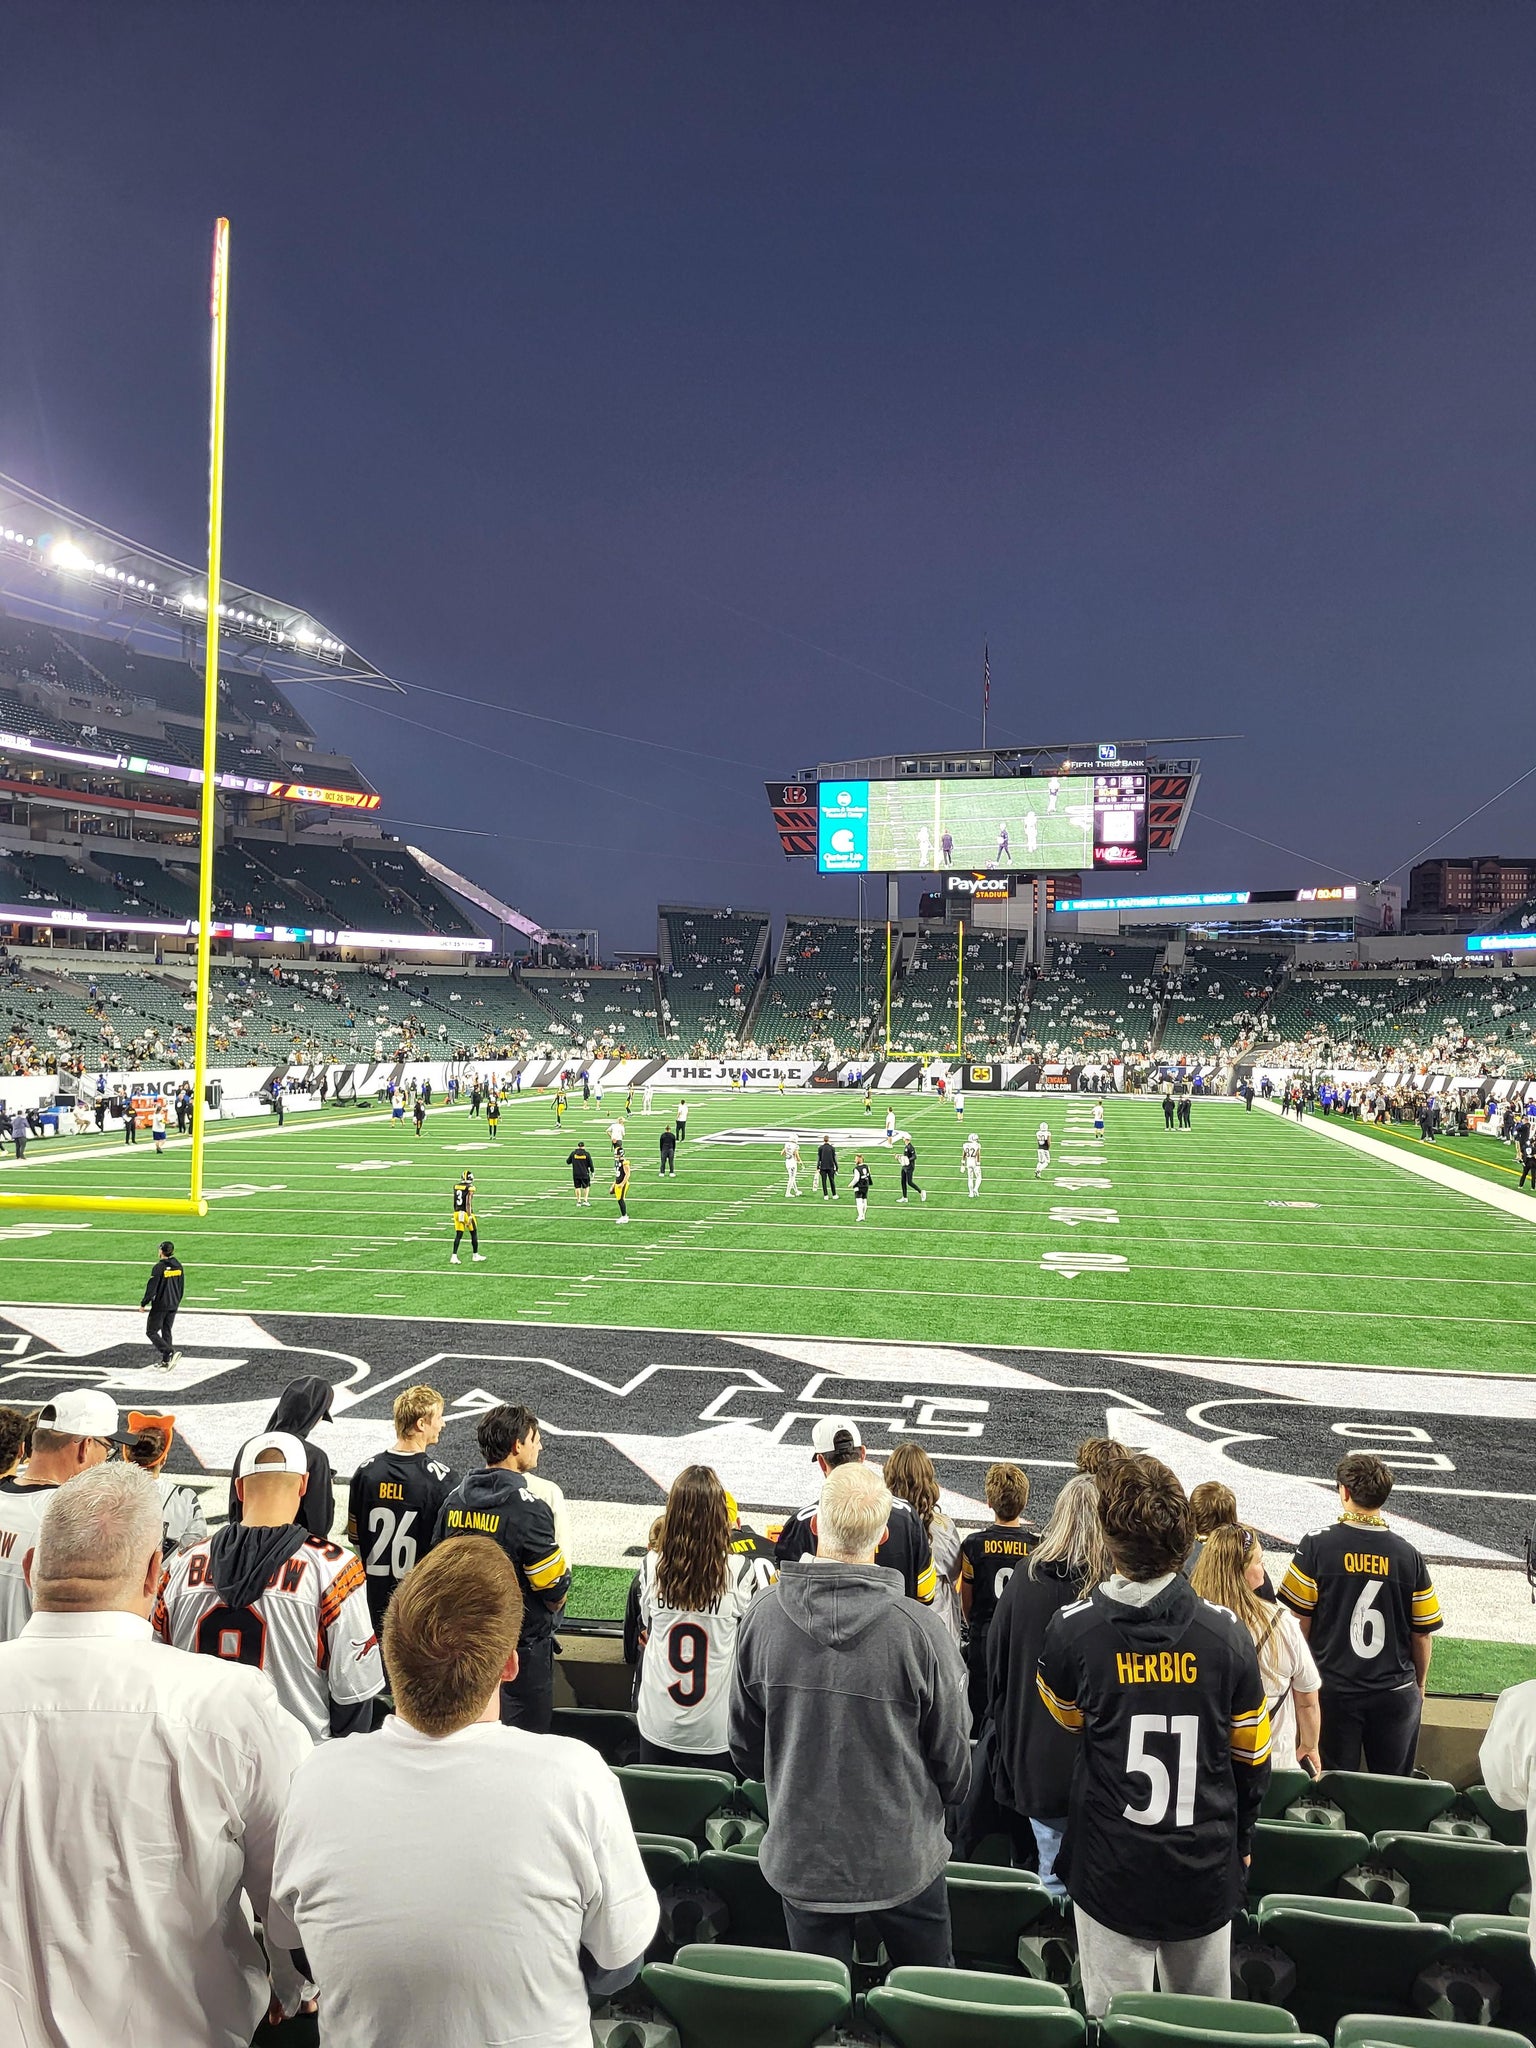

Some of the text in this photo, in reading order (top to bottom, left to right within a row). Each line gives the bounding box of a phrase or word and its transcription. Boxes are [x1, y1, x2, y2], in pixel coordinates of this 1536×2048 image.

[1095, 760, 1121, 768] THIRD
[948, 877, 1008, 893] Paycor
[666, 1067, 712, 1079] THE
[972, 1068, 991, 1081] 25
[456, 1189, 463, 1206] 3
[1047, 1206, 1120, 1224] 20
[1039, 1251, 1131, 1273] 10
[379, 1482, 404, 1500] BELL
[447, 1509, 500, 1534] POLAMALU
[366, 1506, 419, 1581] 26
[731, 1538, 757, 1554] ATT
[984, 1540, 1029, 1556] BOSWELL
[1344, 1552, 1390, 1576] QUEEN
[1349, 1579, 1386, 1659] 6
[667, 1622, 709, 1708] 9
[1116, 1651, 1198, 1684] HERBIG
[1122, 1713, 1200, 1828] 51
